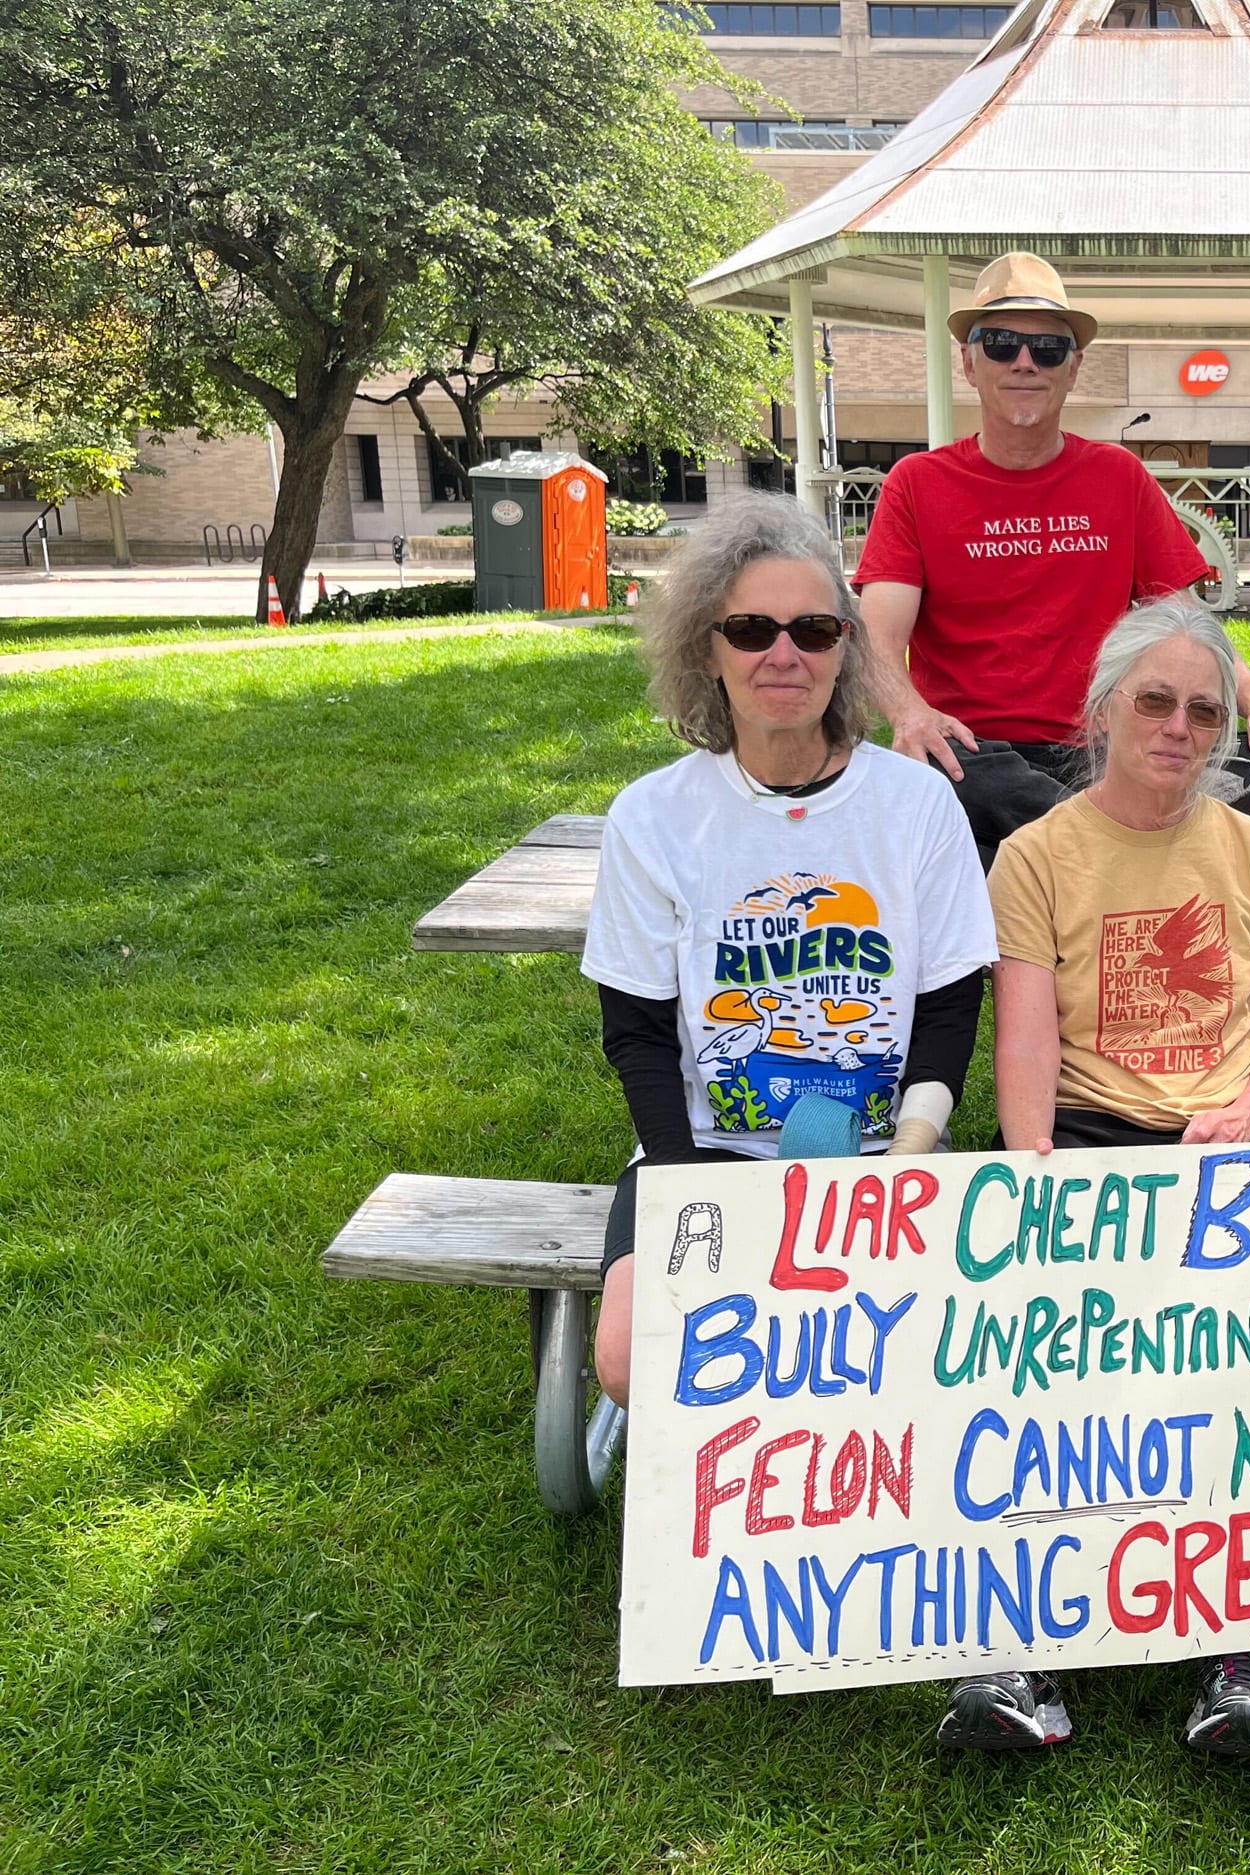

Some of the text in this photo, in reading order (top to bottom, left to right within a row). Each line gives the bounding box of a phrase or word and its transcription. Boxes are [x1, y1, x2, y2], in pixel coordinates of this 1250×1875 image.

[1187, 364, 1229, 382] we
[984, 515, 1090, 536] MAKE LIES
[965, 536, 1109, 558] WRONG AGAIN
[722, 916, 800, 941] LET OUR
[1105, 918, 1161, 938] WE ARE
[714, 926, 895, 985] RIVERS
[1105, 936, 1146, 954] HERE
[1104, 954, 1126, 970] TO
[802, 975, 881, 995] UNITE US
[1104, 968, 1170, 989] PROTECT
[1105, 989, 1136, 1007] THE
[1105, 1003, 1161, 1023] WATER
[1164, 1049, 1205, 1071] LINE
[1209, 1047, 1222, 1066] 3
[793, 1077, 856, 1088] MILWAUKEE
[668, 1202, 722, 1275] A
[769, 1163, 939, 1292] LIAR
[956, 1162, 1179, 1282] CHEAT
[674, 1291, 918, 1407] BULLY
[692, 1415, 915, 1558] FELON
[954, 1408, 1214, 1521] CANNOT
[700, 1534, 1091, 1664] ANYTHING
